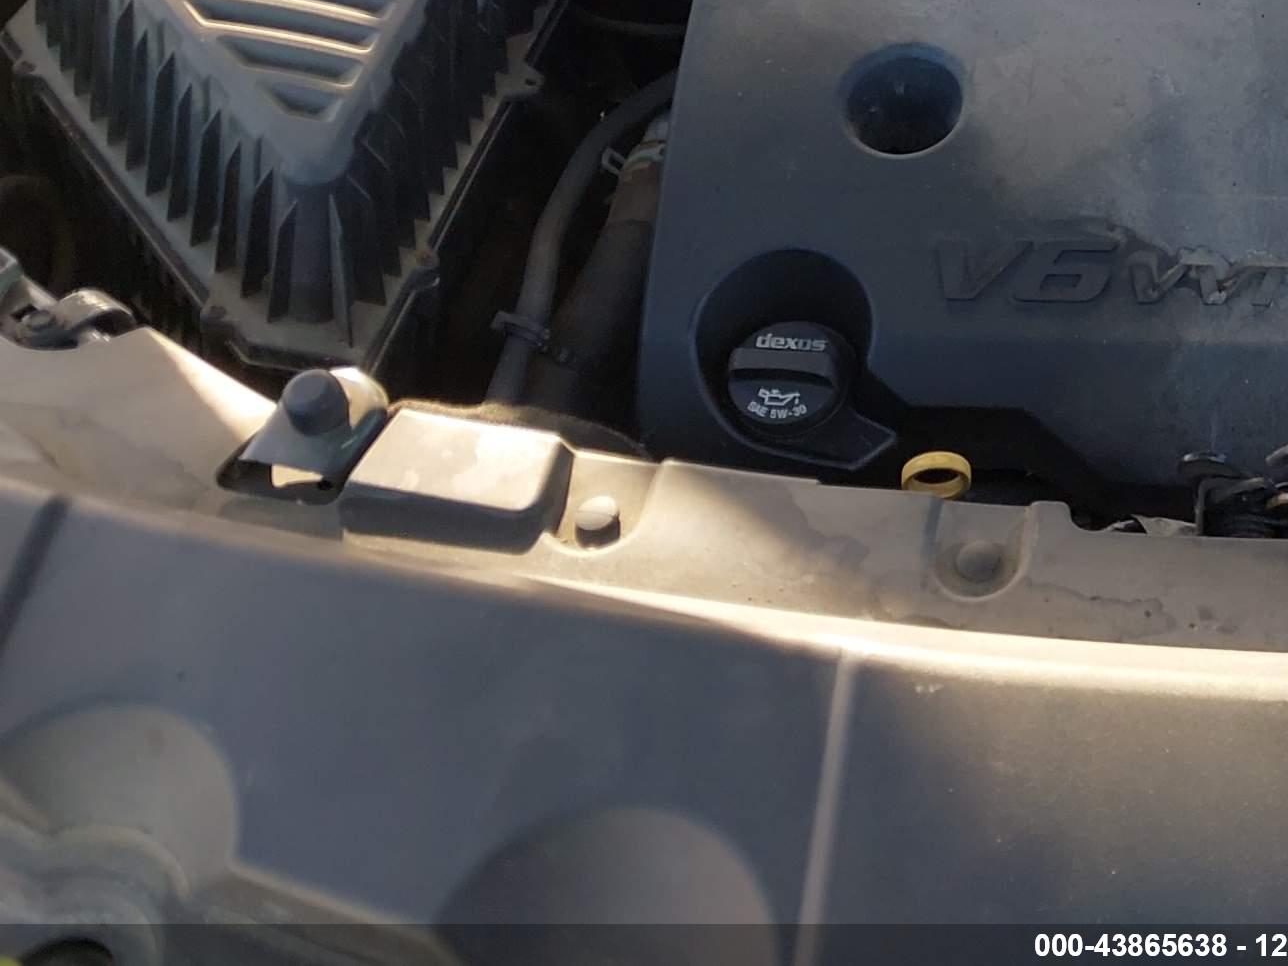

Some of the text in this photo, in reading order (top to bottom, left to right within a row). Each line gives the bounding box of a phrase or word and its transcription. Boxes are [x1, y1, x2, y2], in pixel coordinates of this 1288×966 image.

[935, 240, 1120, 303] V6
[755, 333, 829, 352] dexos
[769, 404, 808, 419] 5W-30
